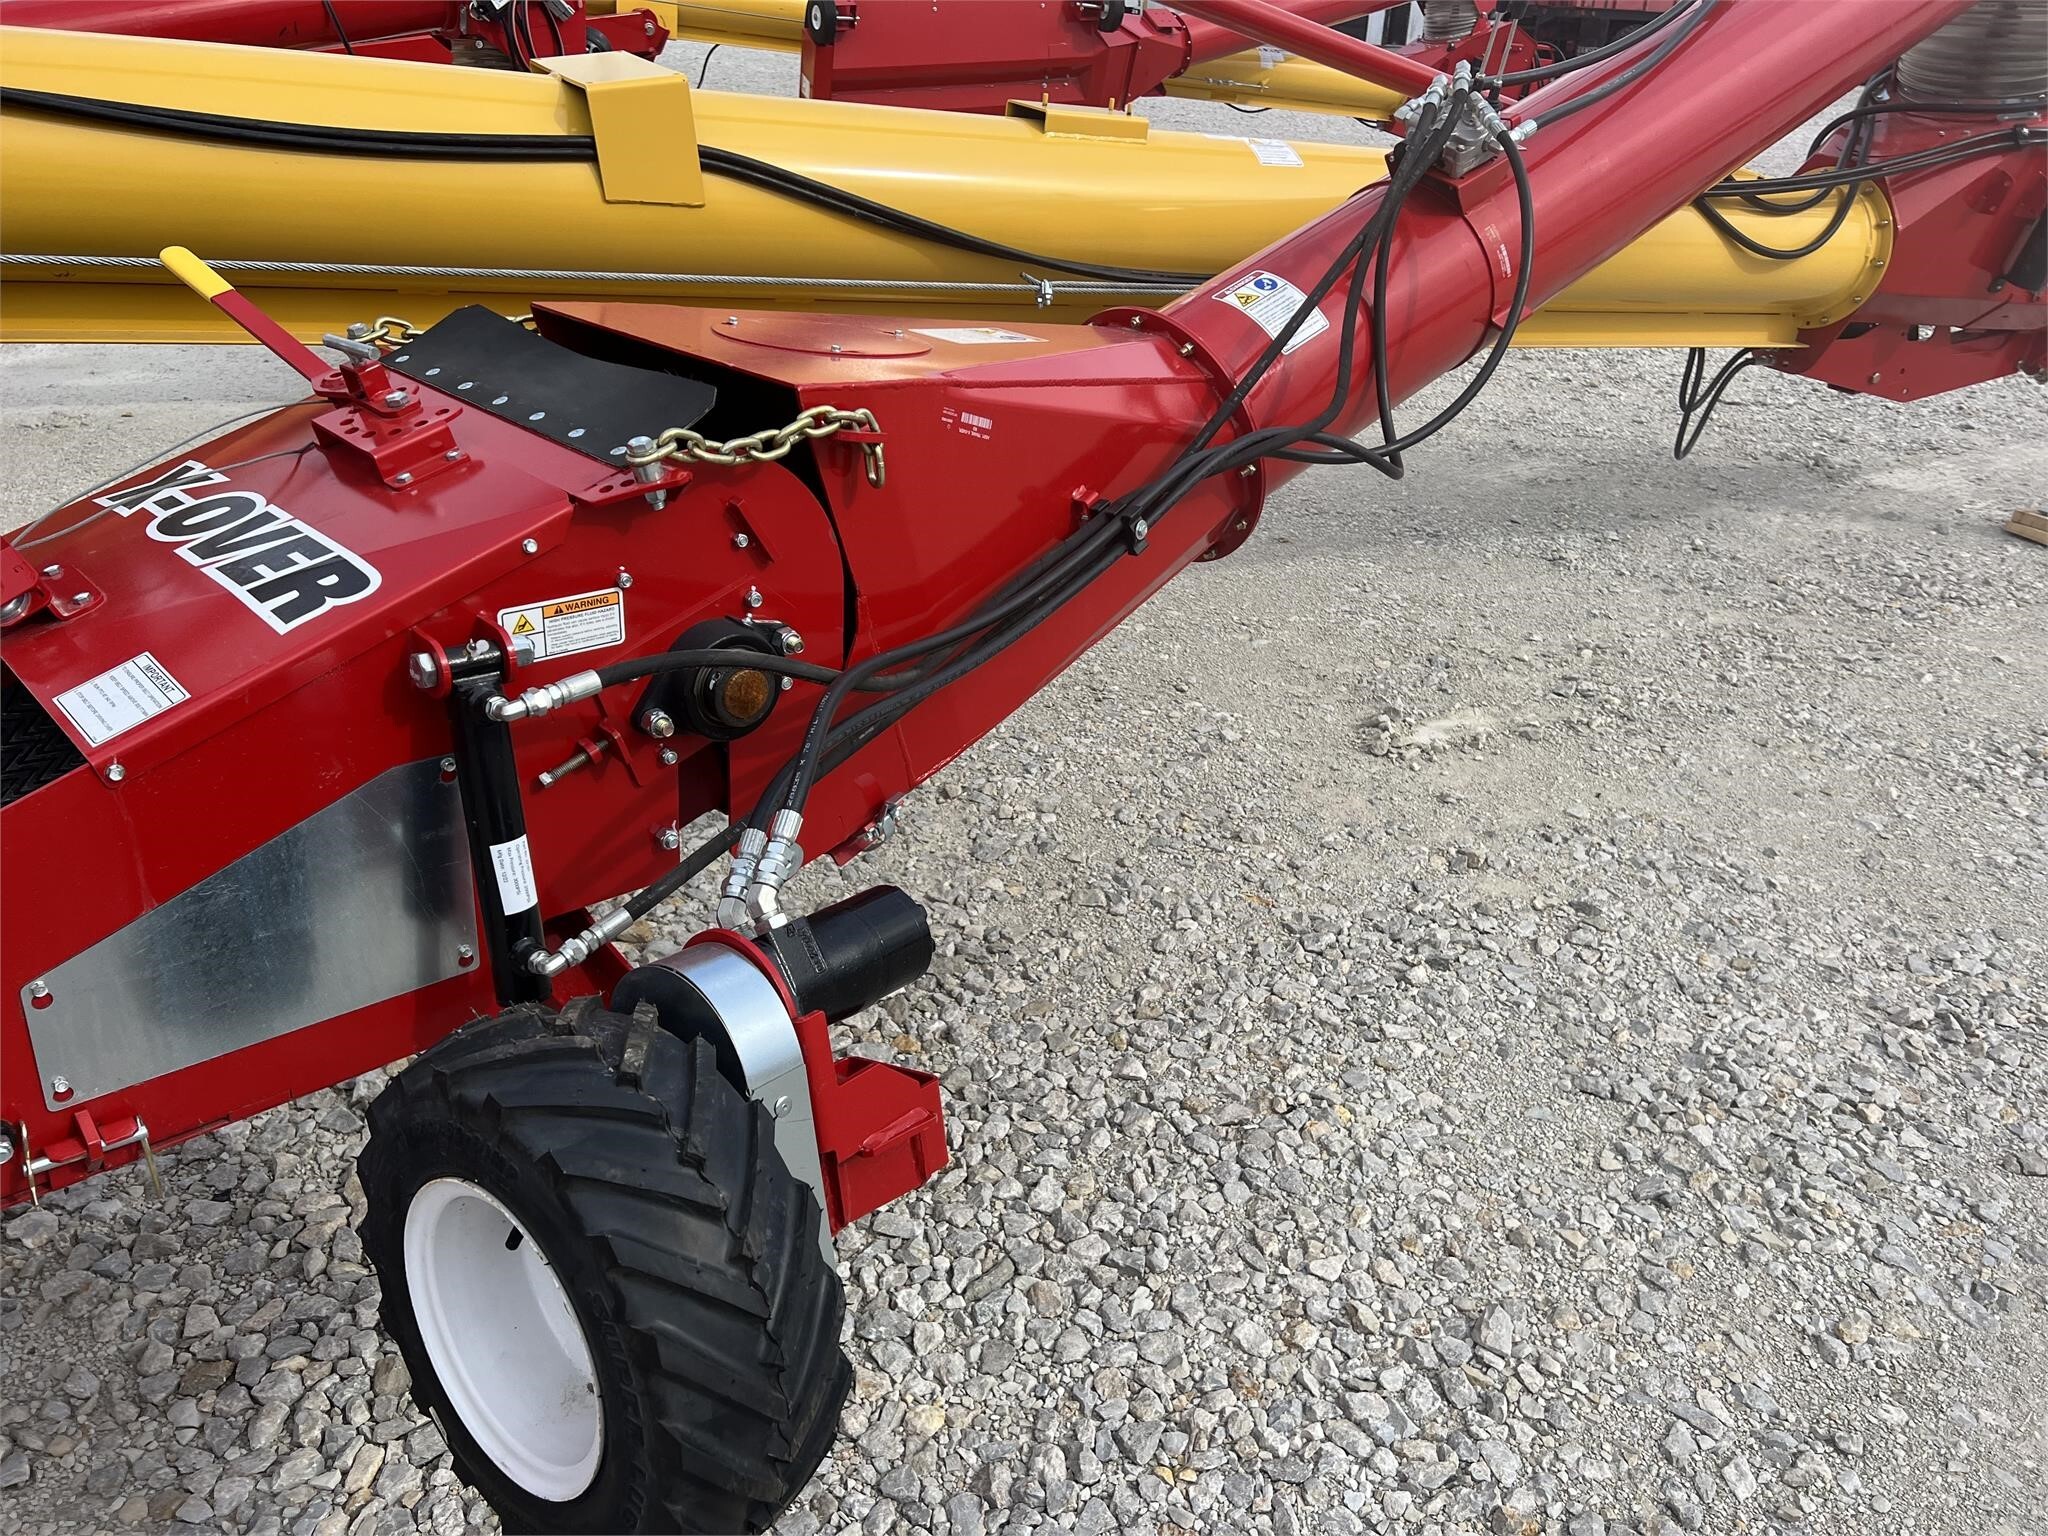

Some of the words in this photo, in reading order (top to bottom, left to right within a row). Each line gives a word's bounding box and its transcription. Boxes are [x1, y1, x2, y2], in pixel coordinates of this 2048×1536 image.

[98, 462, 376, 630] X-OVER
[565, 596, 609, 612] WARNING
[142, 664, 175, 694] IMPORTANT
